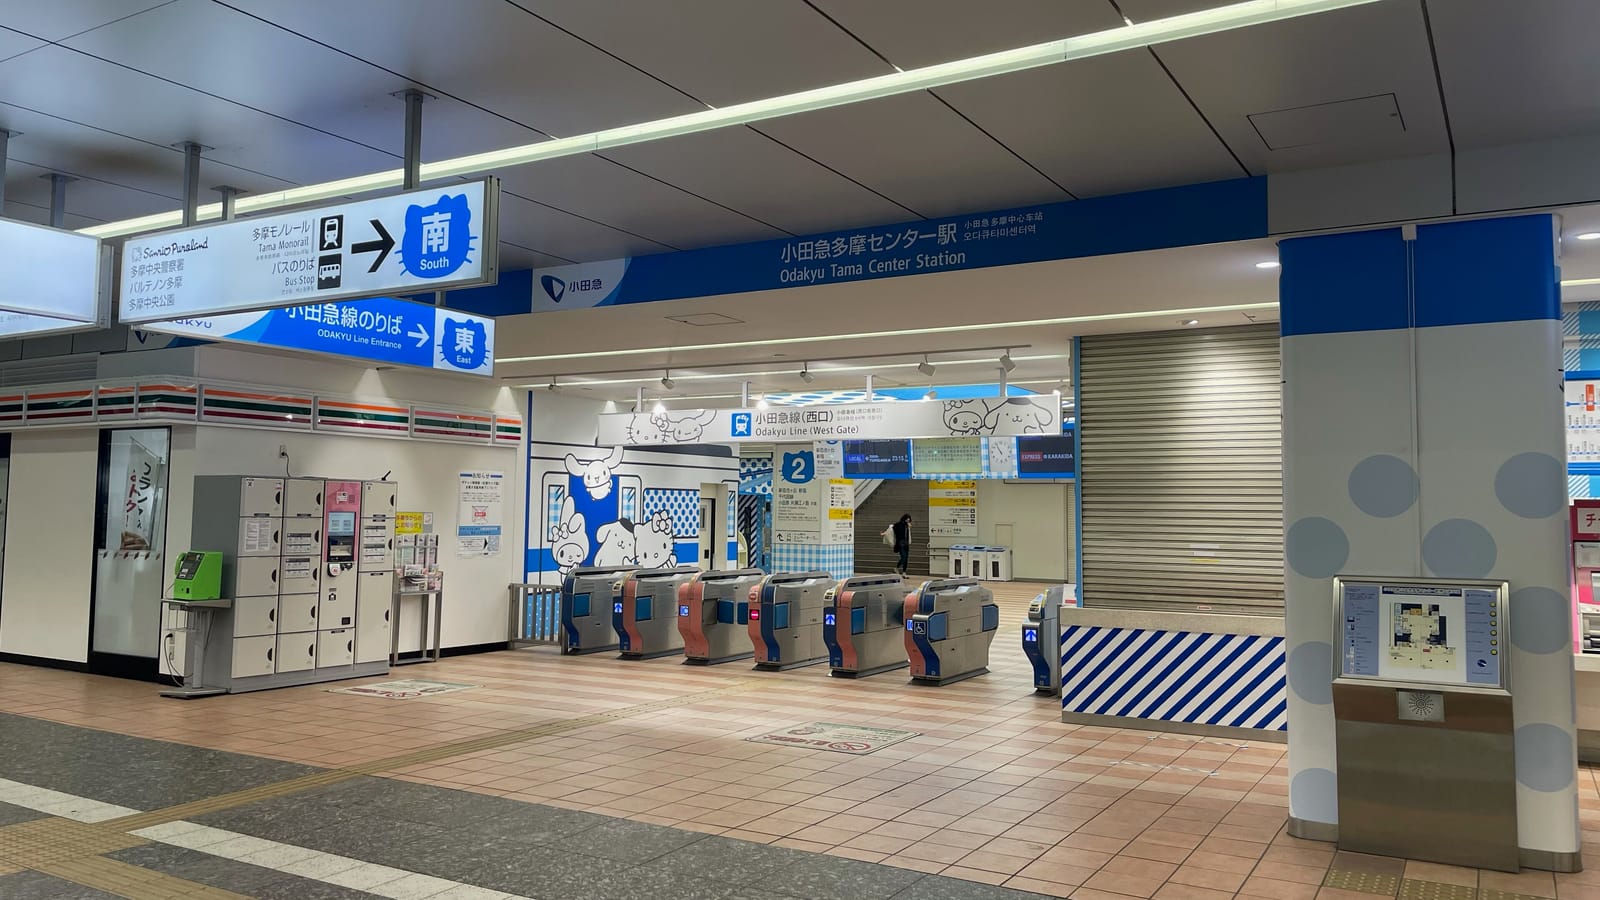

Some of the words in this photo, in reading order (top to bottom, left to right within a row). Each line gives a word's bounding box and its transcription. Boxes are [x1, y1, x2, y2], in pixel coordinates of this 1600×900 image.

[252, 220, 311, 242] 多摩モノレール
[421, 212, 452, 255] 南
[143, 245, 171, 259] Sanrio
[171, 236, 208, 255] Puroland
[259, 243, 277, 253] Tama
[279, 236, 309, 250] Monorail
[781, 223, 957, 263] 小田急多摩センター駅
[130, 258, 185, 279] 多摩中央警察署
[272, 256, 316, 275] バスのりば
[420, 256, 449, 271] South
[780, 267, 825, 283] Odakyu
[830, 263, 862, 278] Tama
[868, 258, 911, 274] Center
[916, 250, 966, 269] Station
[285, 277, 298, 287] Bus
[299, 275, 315, 286] Stop
[569, 279, 602, 293] 小田急
[128, 294, 175, 311] 多摩中央公園
[285, 303, 403, 335] 小田急線のりば
[317, 329, 352, 342] ODAKYU
[353, 335, 369, 344] Line
[371, 338, 402, 350] Entrance
[454, 327, 475, 354] 東
[456, 355, 471, 365] East
[756, 427, 787, 437] Odakyu
[790, 427, 808, 435] Line
[810, 426, 834, 436] (West
[836, 425, 859, 435] Gate)
[791, 457, 806, 479] 2
